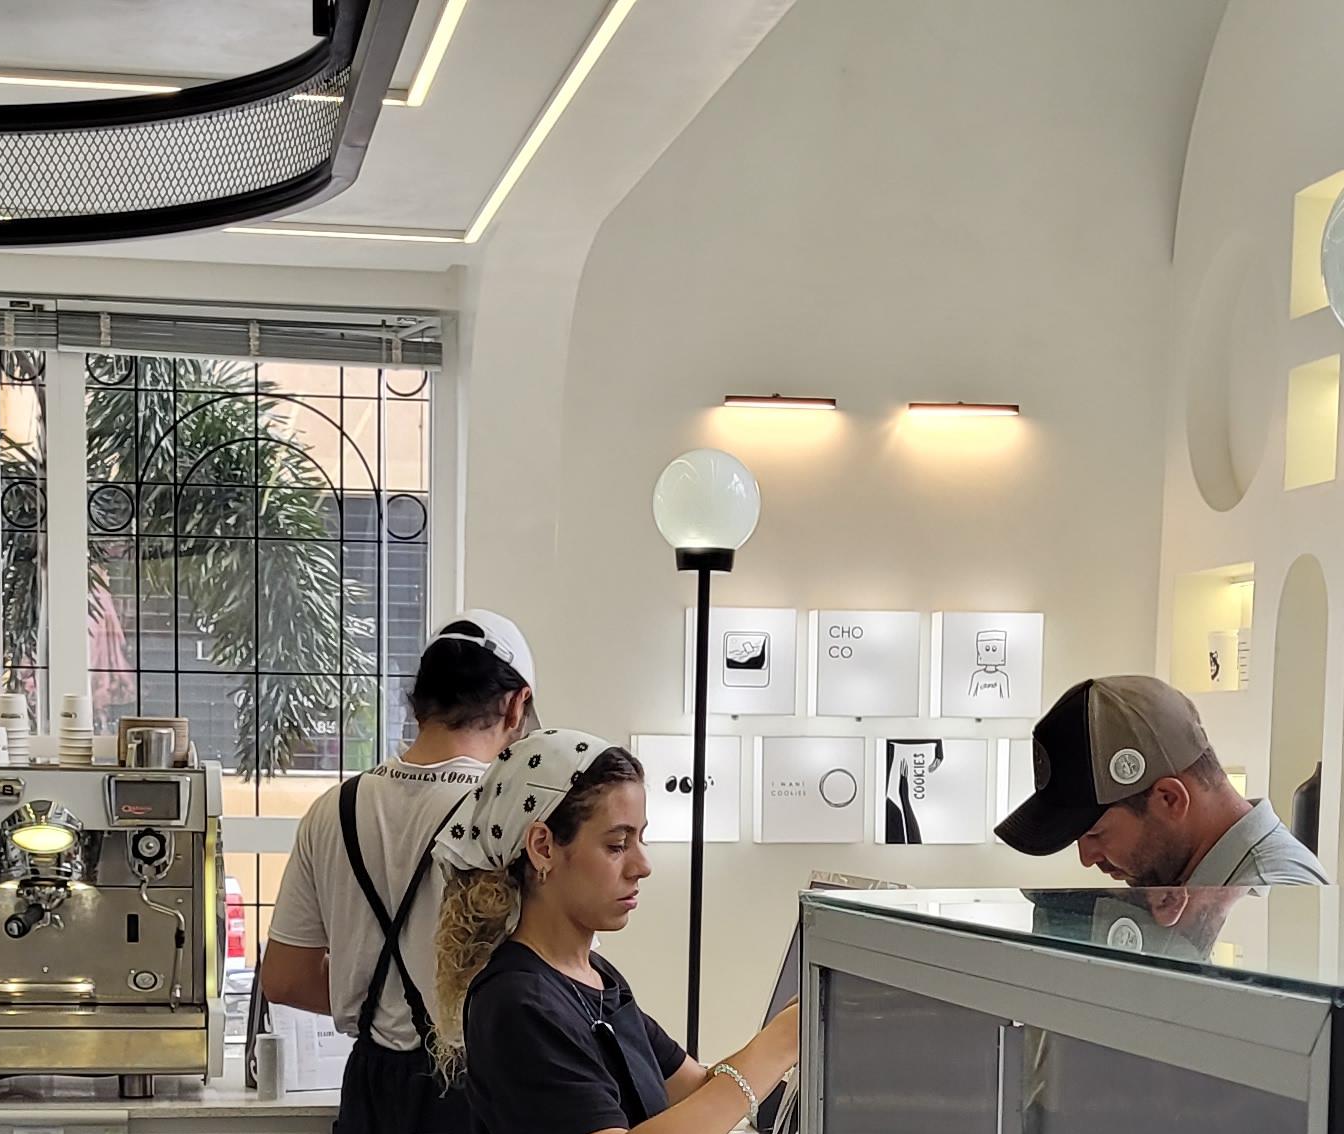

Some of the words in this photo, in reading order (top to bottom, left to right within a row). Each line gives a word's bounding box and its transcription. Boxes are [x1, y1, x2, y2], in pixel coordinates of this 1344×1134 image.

[829, 625, 863, 639] CHO
[828, 645, 853, 659] CO
[913, 752, 925, 800] COOKIES
